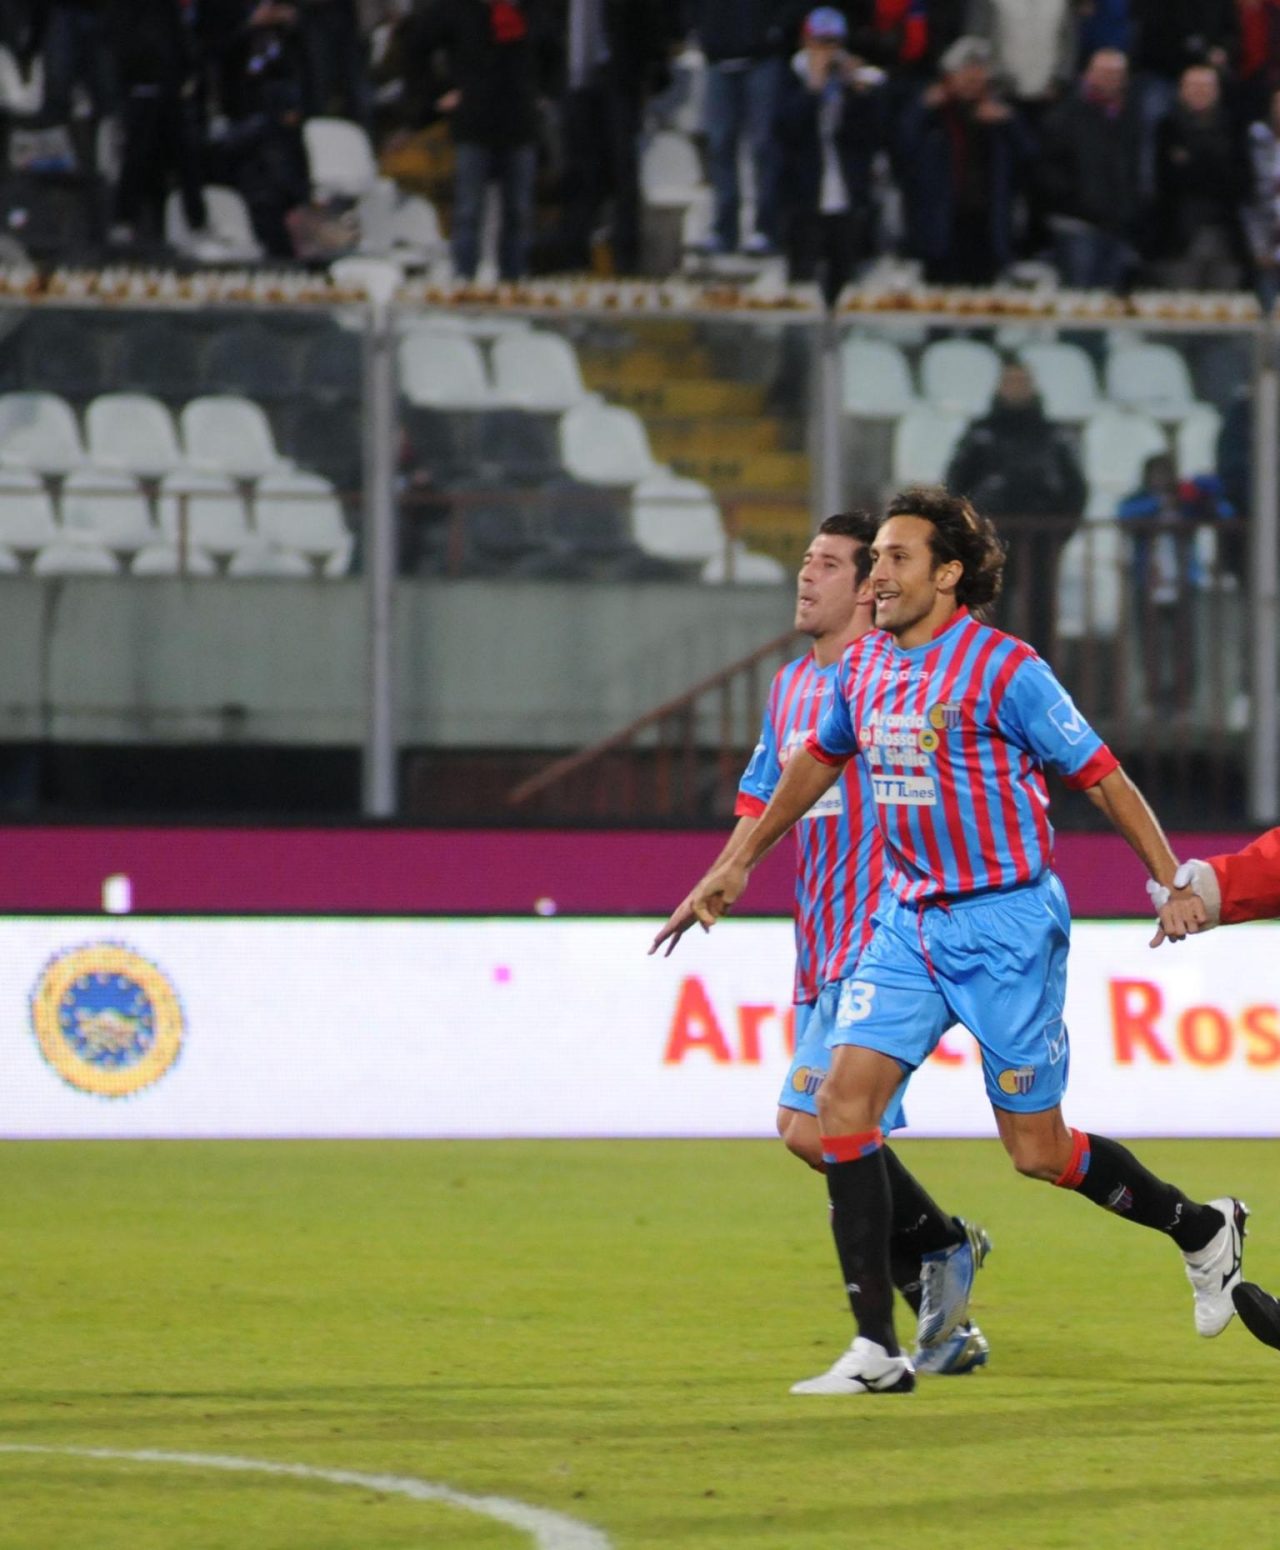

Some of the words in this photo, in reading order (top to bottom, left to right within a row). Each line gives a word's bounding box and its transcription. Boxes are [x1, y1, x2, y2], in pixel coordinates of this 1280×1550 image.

[868, 708, 925, 729] Arancia
[873, 727, 917, 747] Rossa
[884, 746, 930, 768] Sicilia
